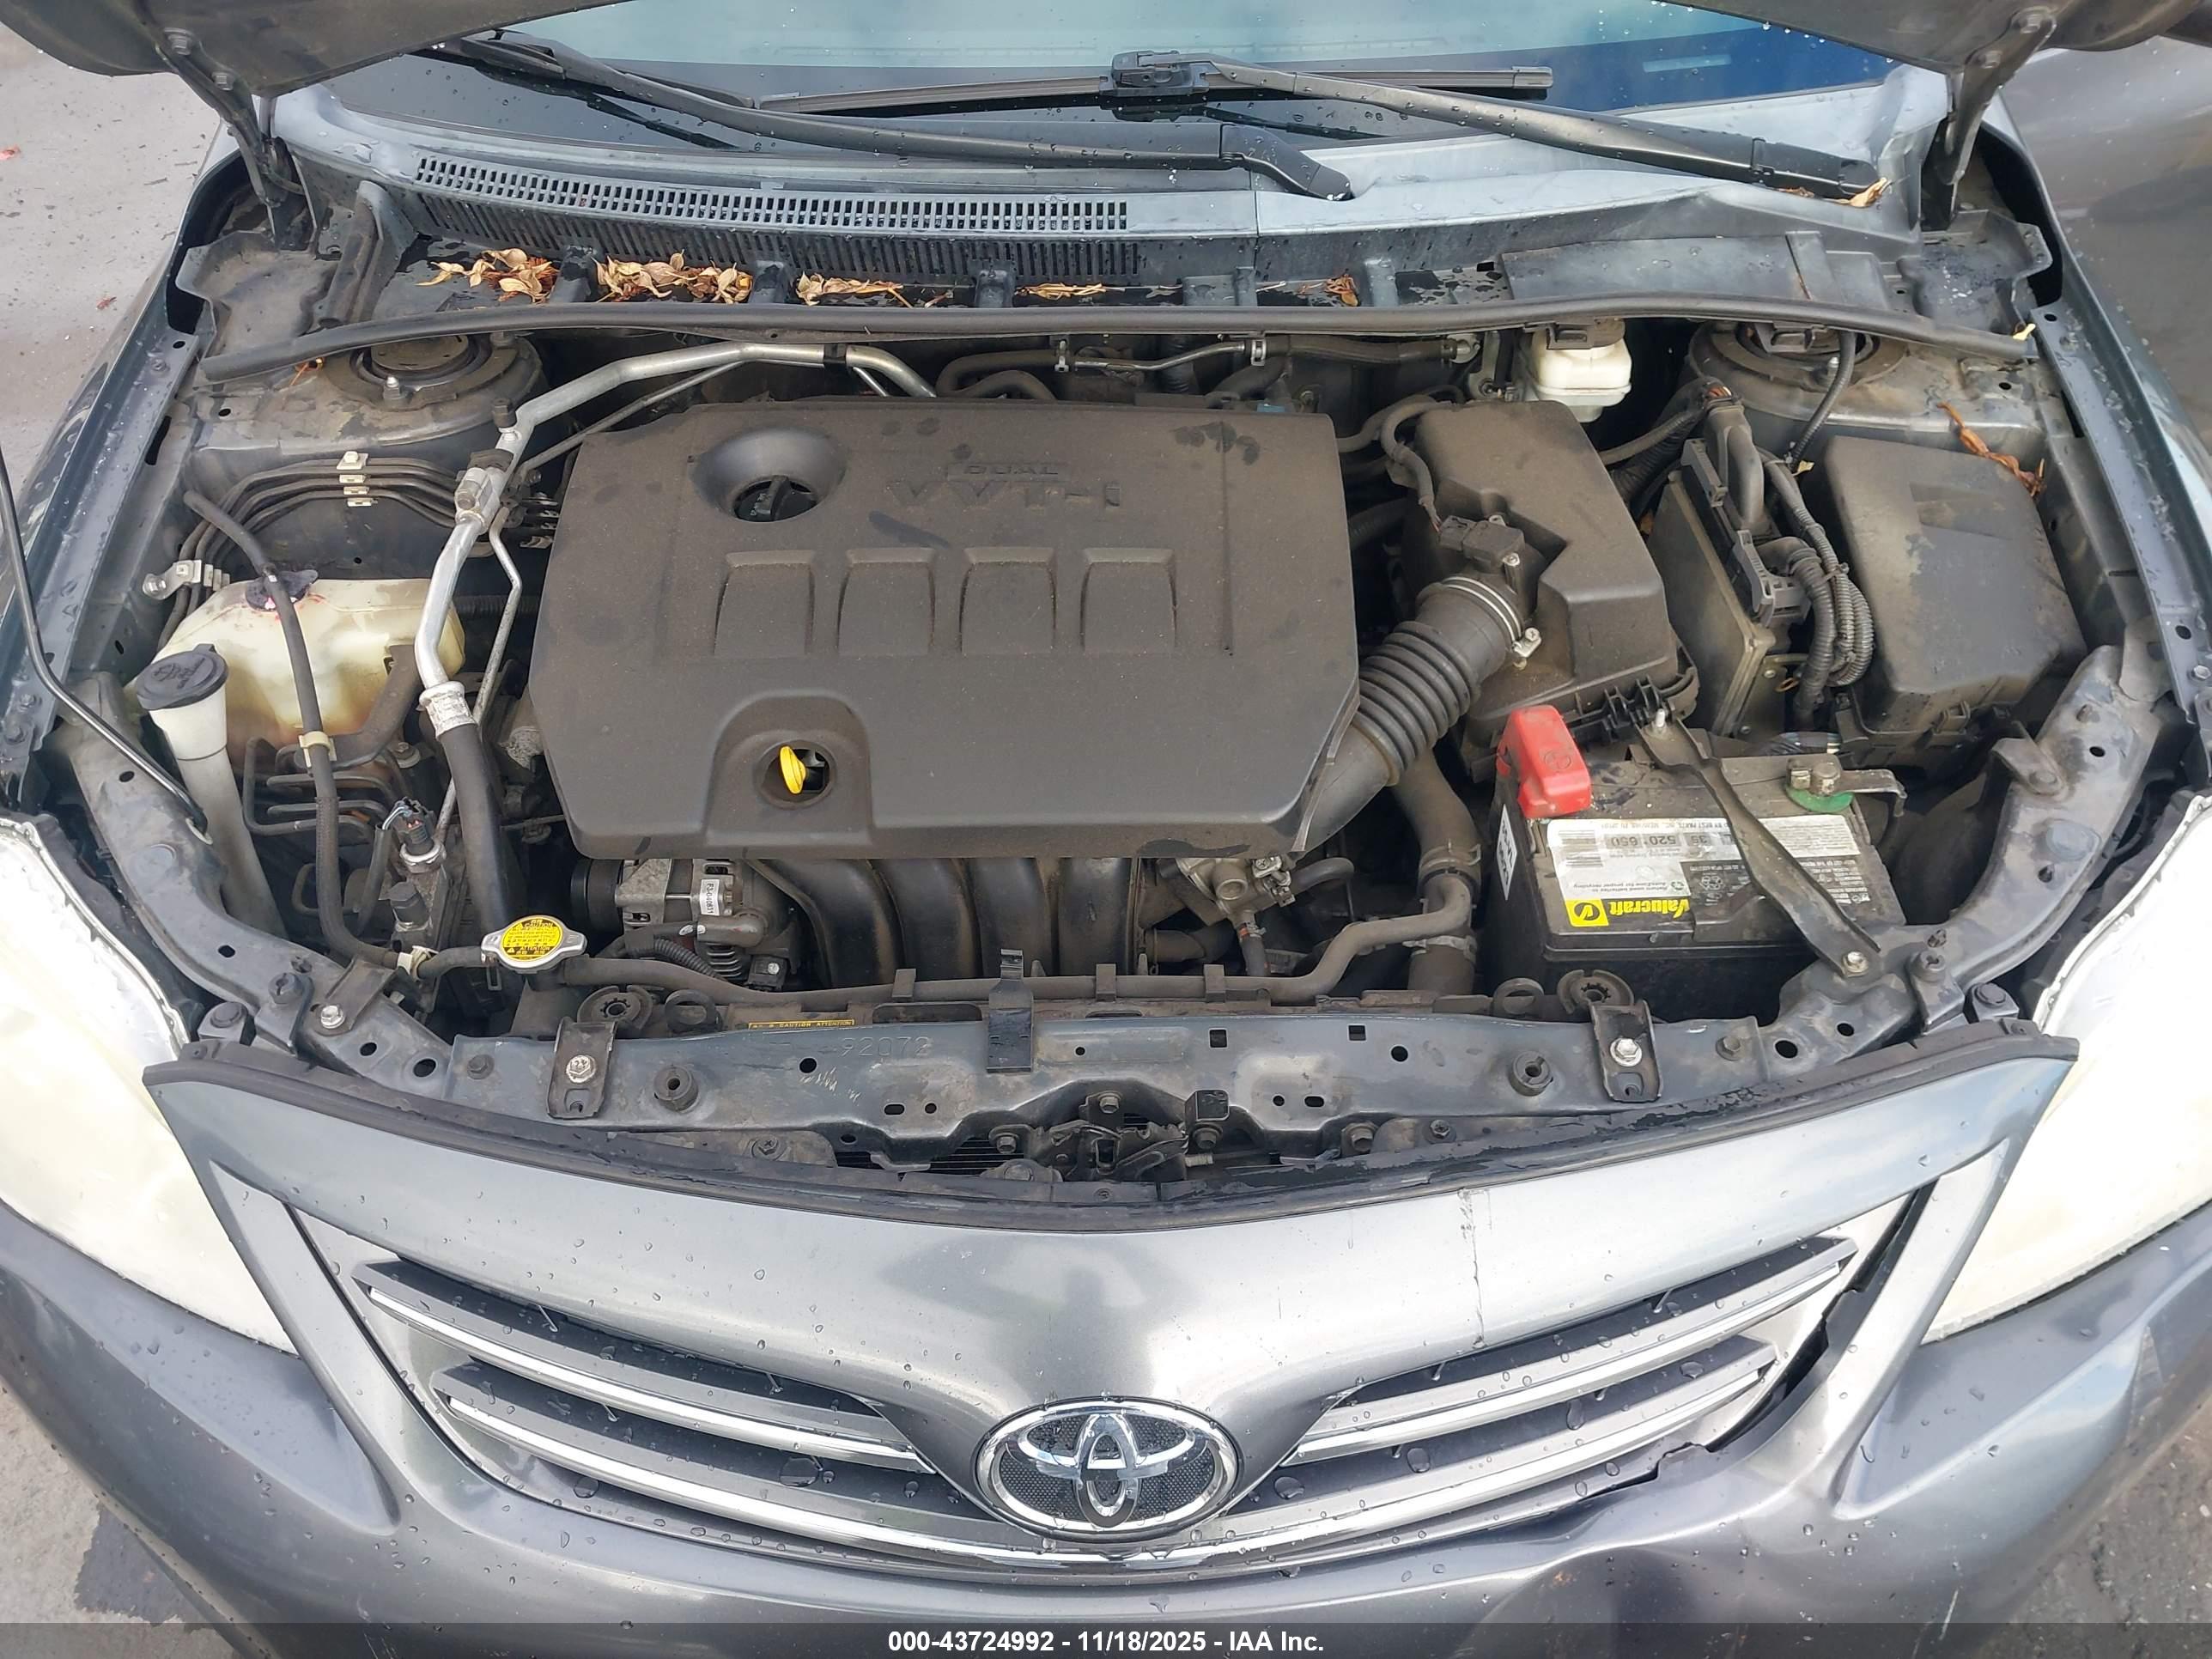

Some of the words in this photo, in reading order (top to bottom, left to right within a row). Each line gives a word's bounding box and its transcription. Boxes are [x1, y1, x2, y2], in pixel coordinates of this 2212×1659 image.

[1610, 836, 1638, 847] 650
[1650, 836, 1676, 846] 520
[1691, 835, 1708, 844] 35
[1608, 899, 1690, 918] Valucraft
